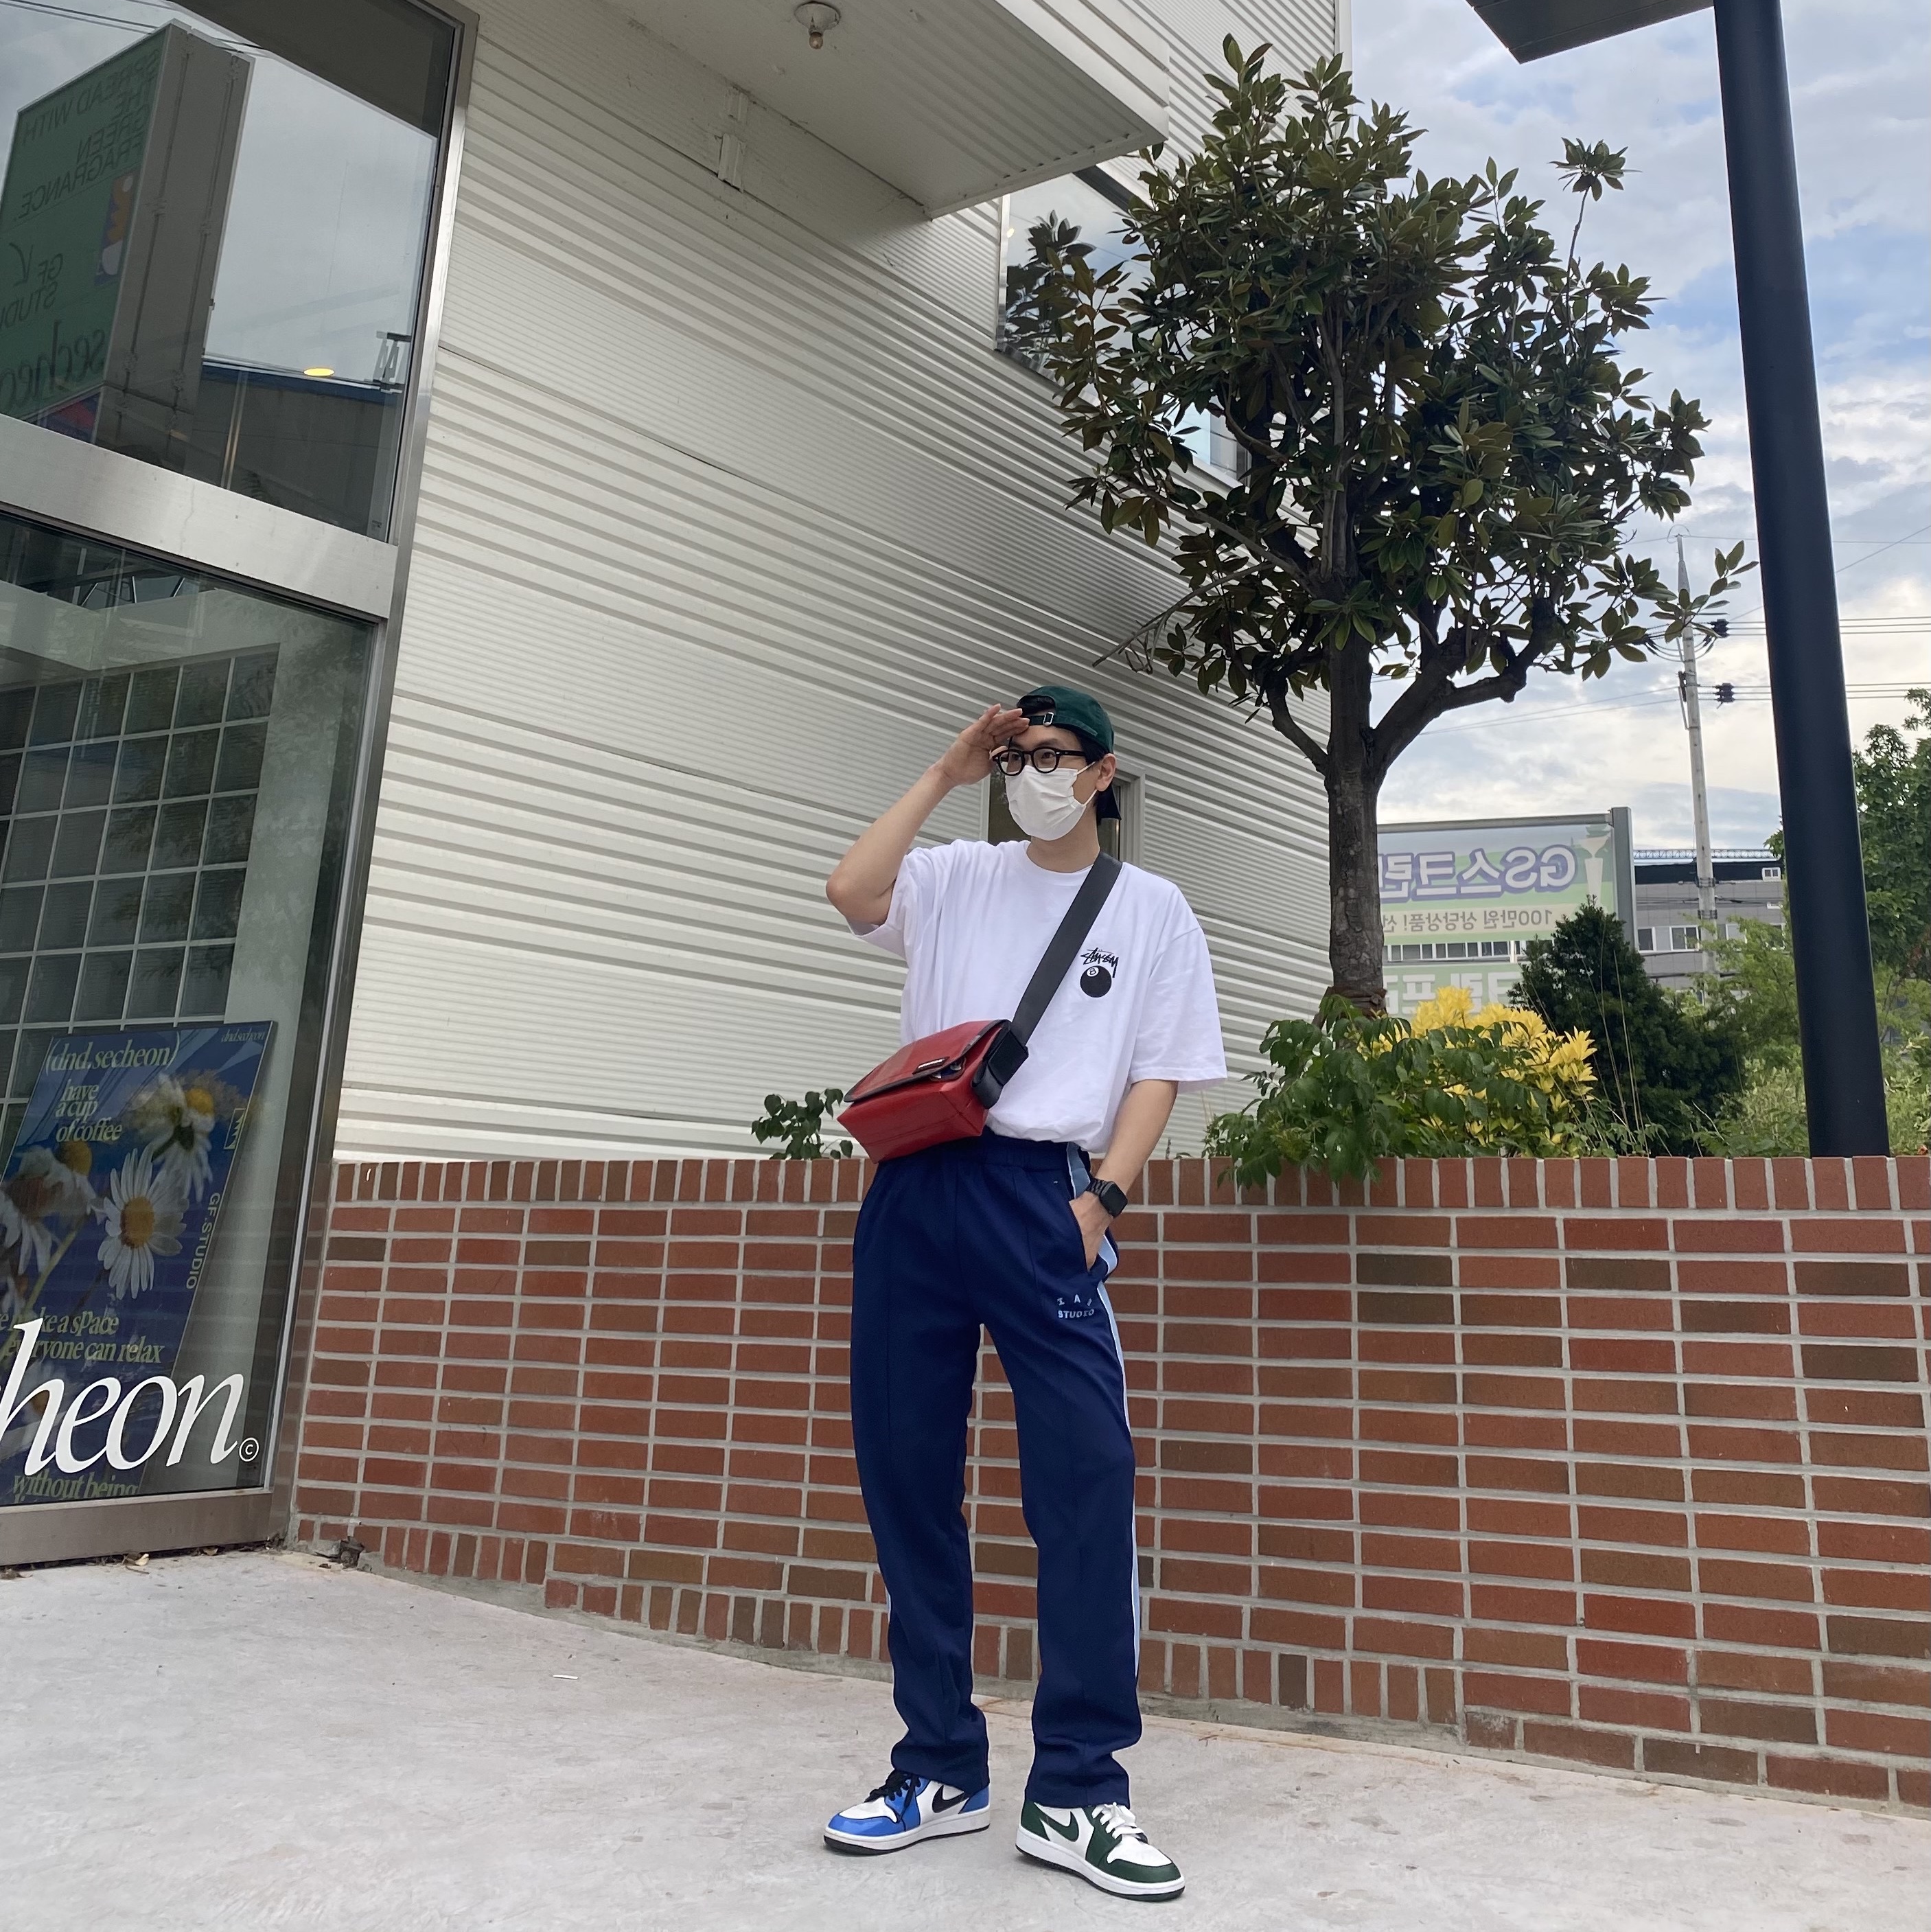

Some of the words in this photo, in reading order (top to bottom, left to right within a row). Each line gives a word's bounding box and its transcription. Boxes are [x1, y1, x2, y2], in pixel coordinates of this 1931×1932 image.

[60, 1079, 99, 1101] have
[55, 1101, 66, 1117] a
[67, 1101, 99, 1123] cup
[56, 1118, 80, 1142] of
[76, 1117, 122, 1141] coffee
[57, 1315, 69, 1333] a
[1058, 1309, 1094, 1318] STUDIO
[84, 1342, 116, 1361] can
[117, 1335, 165, 1364] relax
[13, 1468, 84, 1499] without
